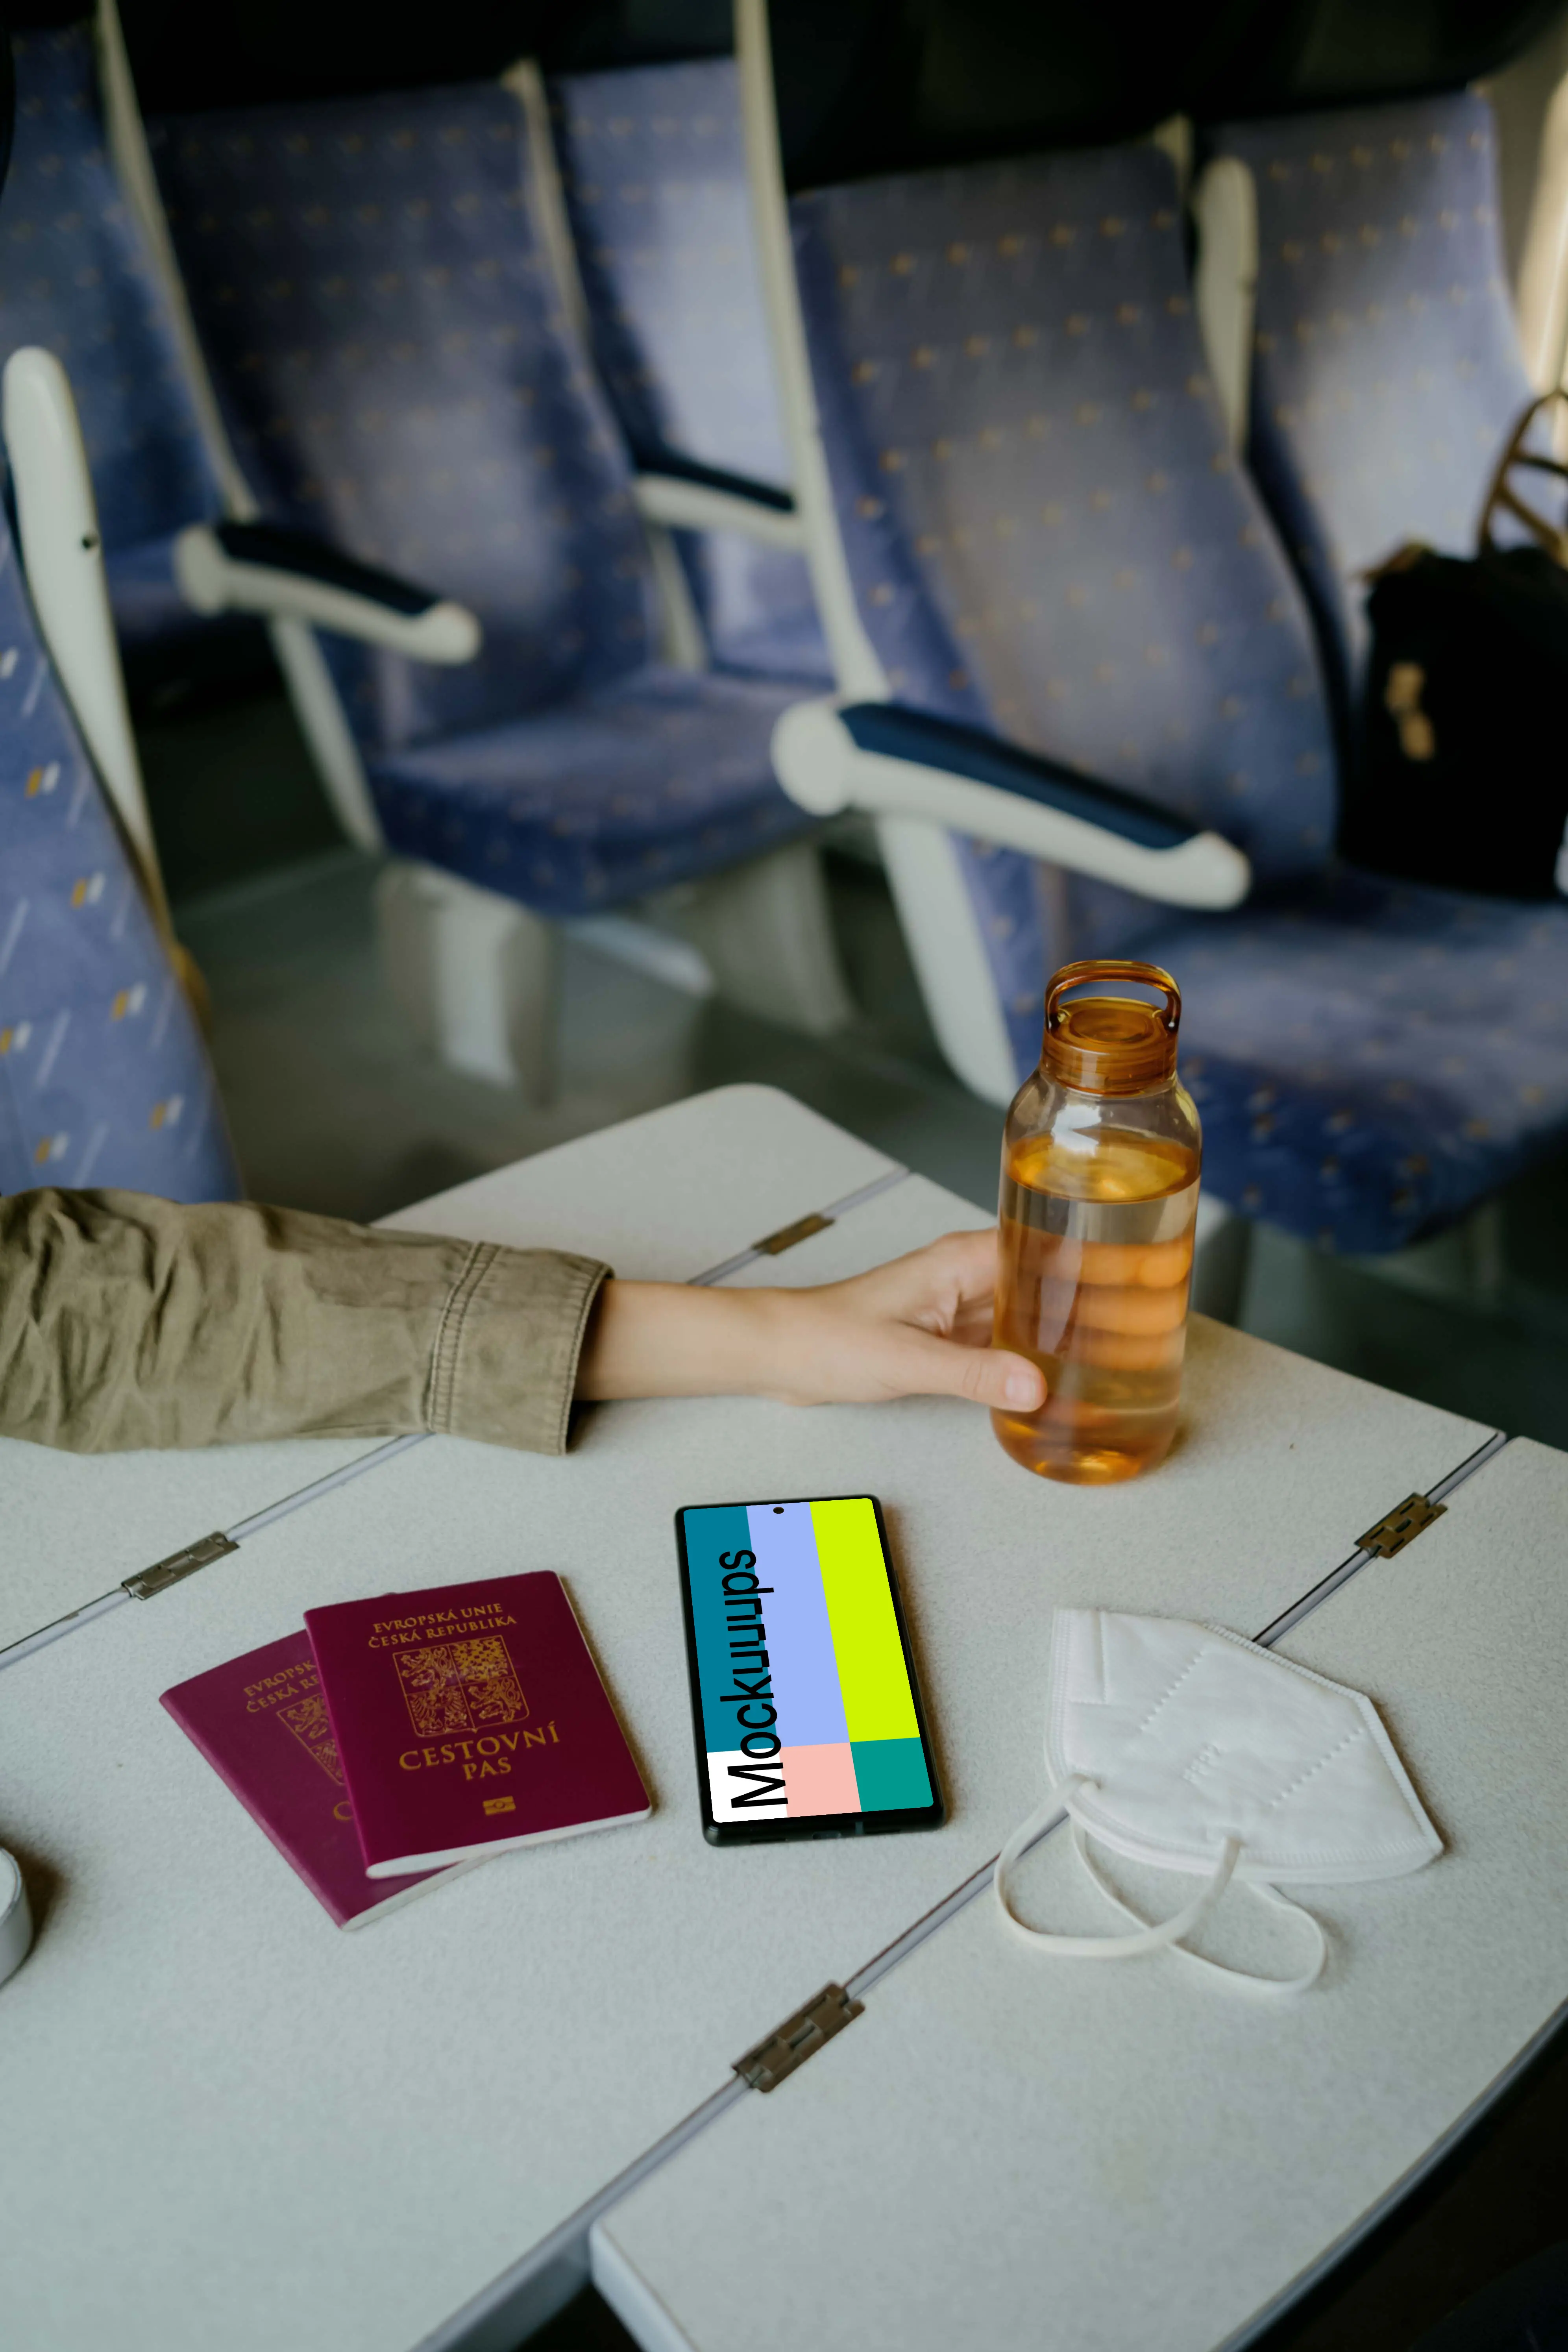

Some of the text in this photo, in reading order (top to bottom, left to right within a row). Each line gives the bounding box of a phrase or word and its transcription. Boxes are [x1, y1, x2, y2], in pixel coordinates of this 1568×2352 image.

[368, 1615, 517, 1648] ČESKÁ REPUBLIKA
[373, 1603, 503, 1633] EVROPSKÁ UNIE
[243, 1659, 316, 1697] EVROPSK
[719, 1550, 788, 1808] Mockuuups
[399, 1721, 560, 1770] CESTOVNÍ
[462, 1757, 512, 1781] PAS
